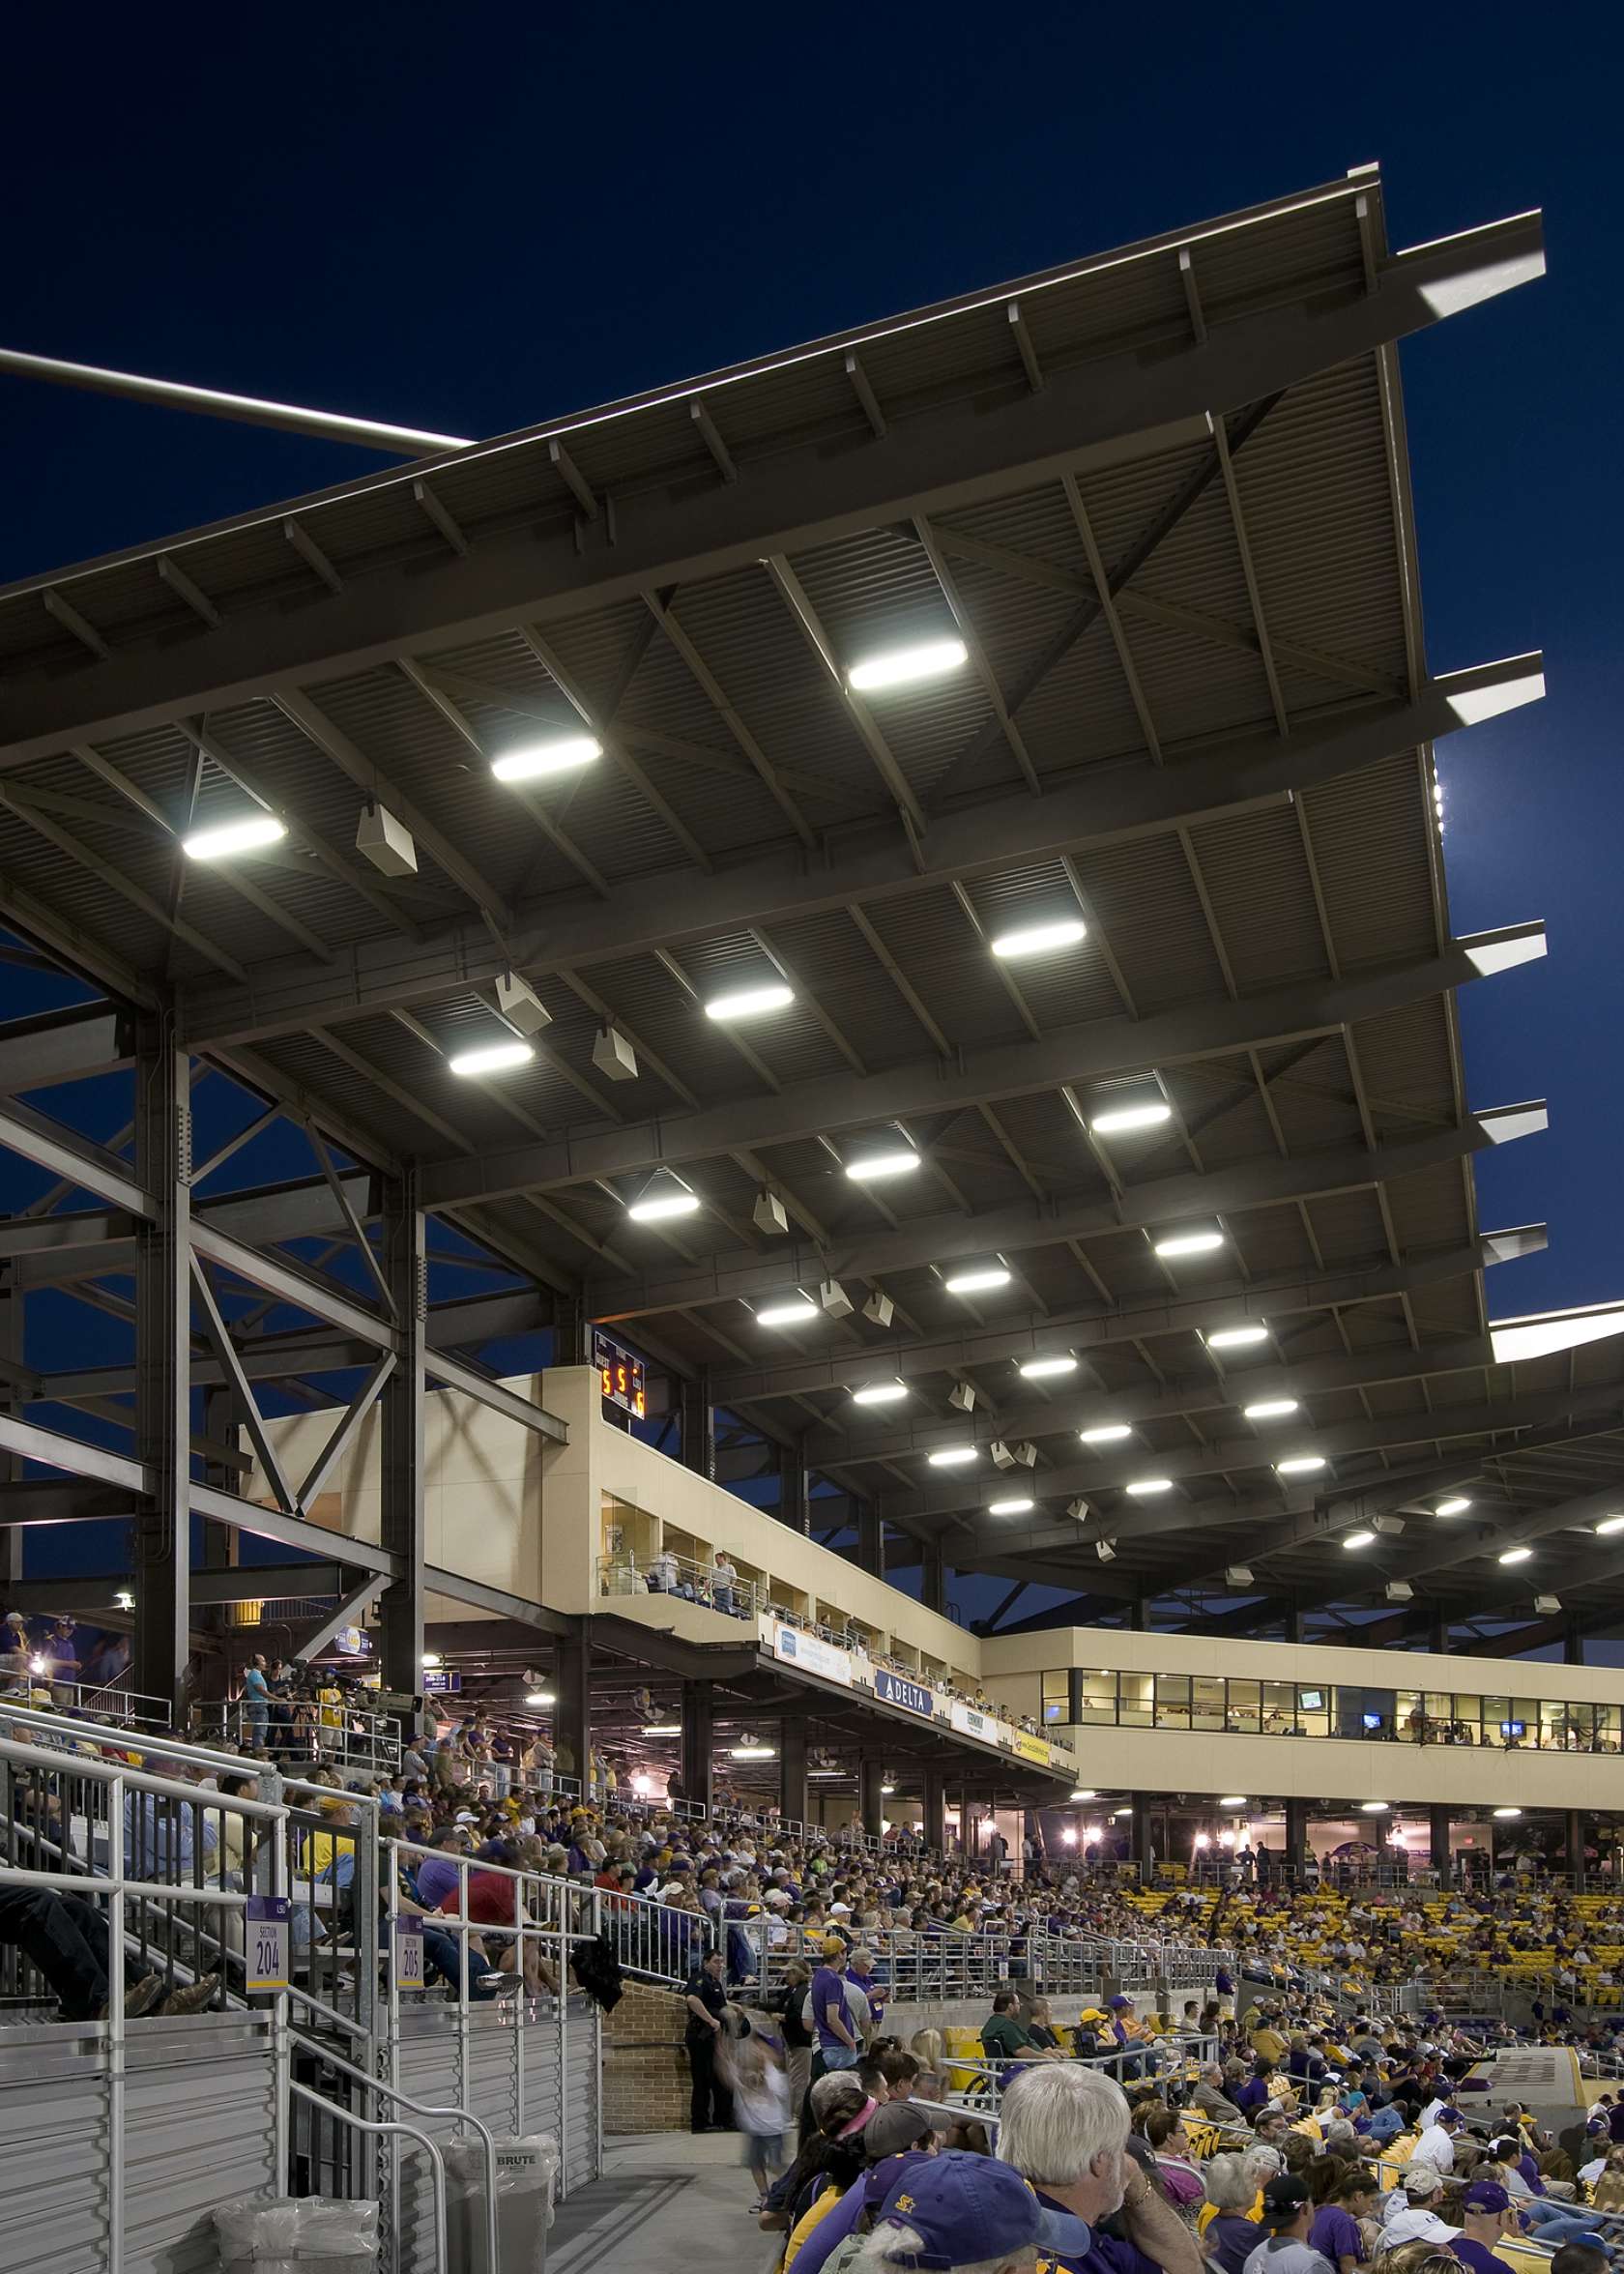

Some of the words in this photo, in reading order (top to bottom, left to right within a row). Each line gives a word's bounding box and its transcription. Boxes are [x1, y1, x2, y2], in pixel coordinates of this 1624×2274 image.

[603, 1369, 611, 1394] 5
[618, 1368, 625, 1392] 5
[895, 1680, 924, 1710] DELTA
[276, 1904, 286, 1914] LSU
[256, 1940, 279, 1976] 204
[403, 1948, 419, 1978] 205
[497, 2155, 536, 2166] BRUTE
